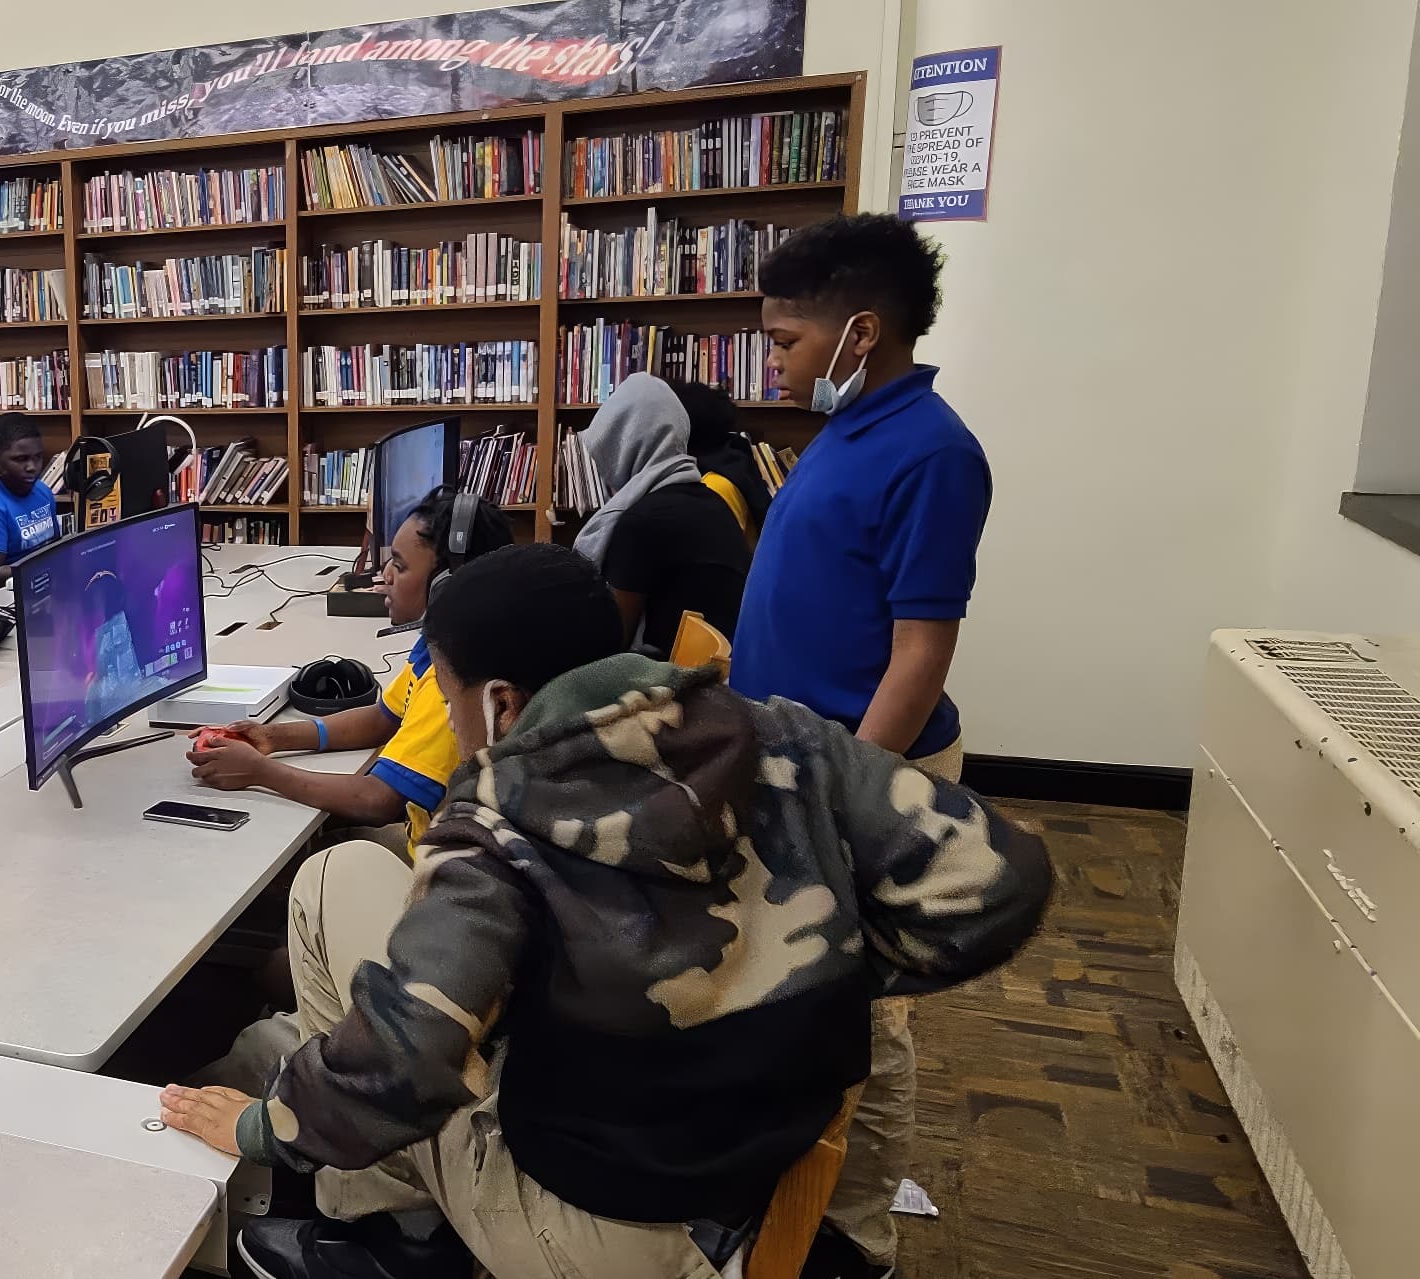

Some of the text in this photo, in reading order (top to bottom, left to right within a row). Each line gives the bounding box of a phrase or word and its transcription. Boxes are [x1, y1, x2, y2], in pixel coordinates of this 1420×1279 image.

[10, 86, 29, 111] the
[24, 101, 57, 127] moon.
[57, 114, 89, 135] Even
[89, 117, 108, 136] if
[102, 116, 136, 140] you
[289, 31, 372, 67] land
[366, 38, 489, 72] among
[480, 32, 550, 71] the
[541, 20, 666, 76] stars!
[919, 126, 975, 141] PREVENT
[917, 139, 961, 154] SPREAD
[965, 137, 985, 148] OF
[931, 162, 969, 176] WEAR
[971, 162, 982, 173] A
[927, 174, 966, 188] MASK
[937, 194, 970, 208] YOU
